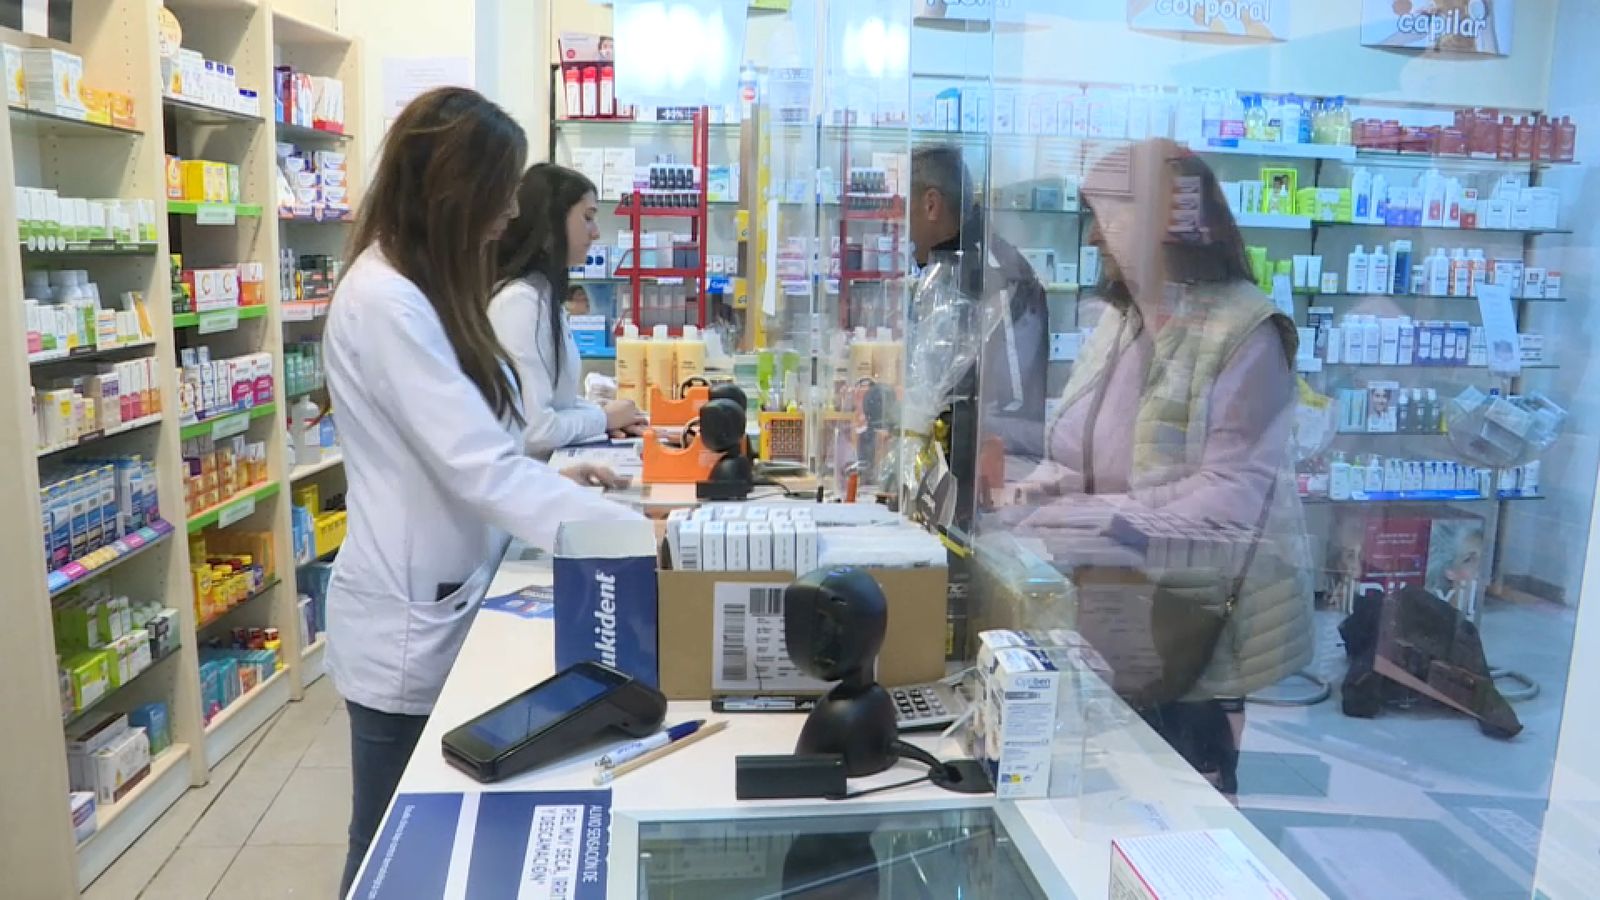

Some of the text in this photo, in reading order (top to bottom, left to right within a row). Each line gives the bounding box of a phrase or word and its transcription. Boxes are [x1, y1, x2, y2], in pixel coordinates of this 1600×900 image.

[1155, 0, 1271, 26] corporal
[1397, 8, 1486, 41] capilar
[594, 569, 616, 670] ukident
[558, 827, 574, 847] MUY
[582, 871, 598, 883] DE
